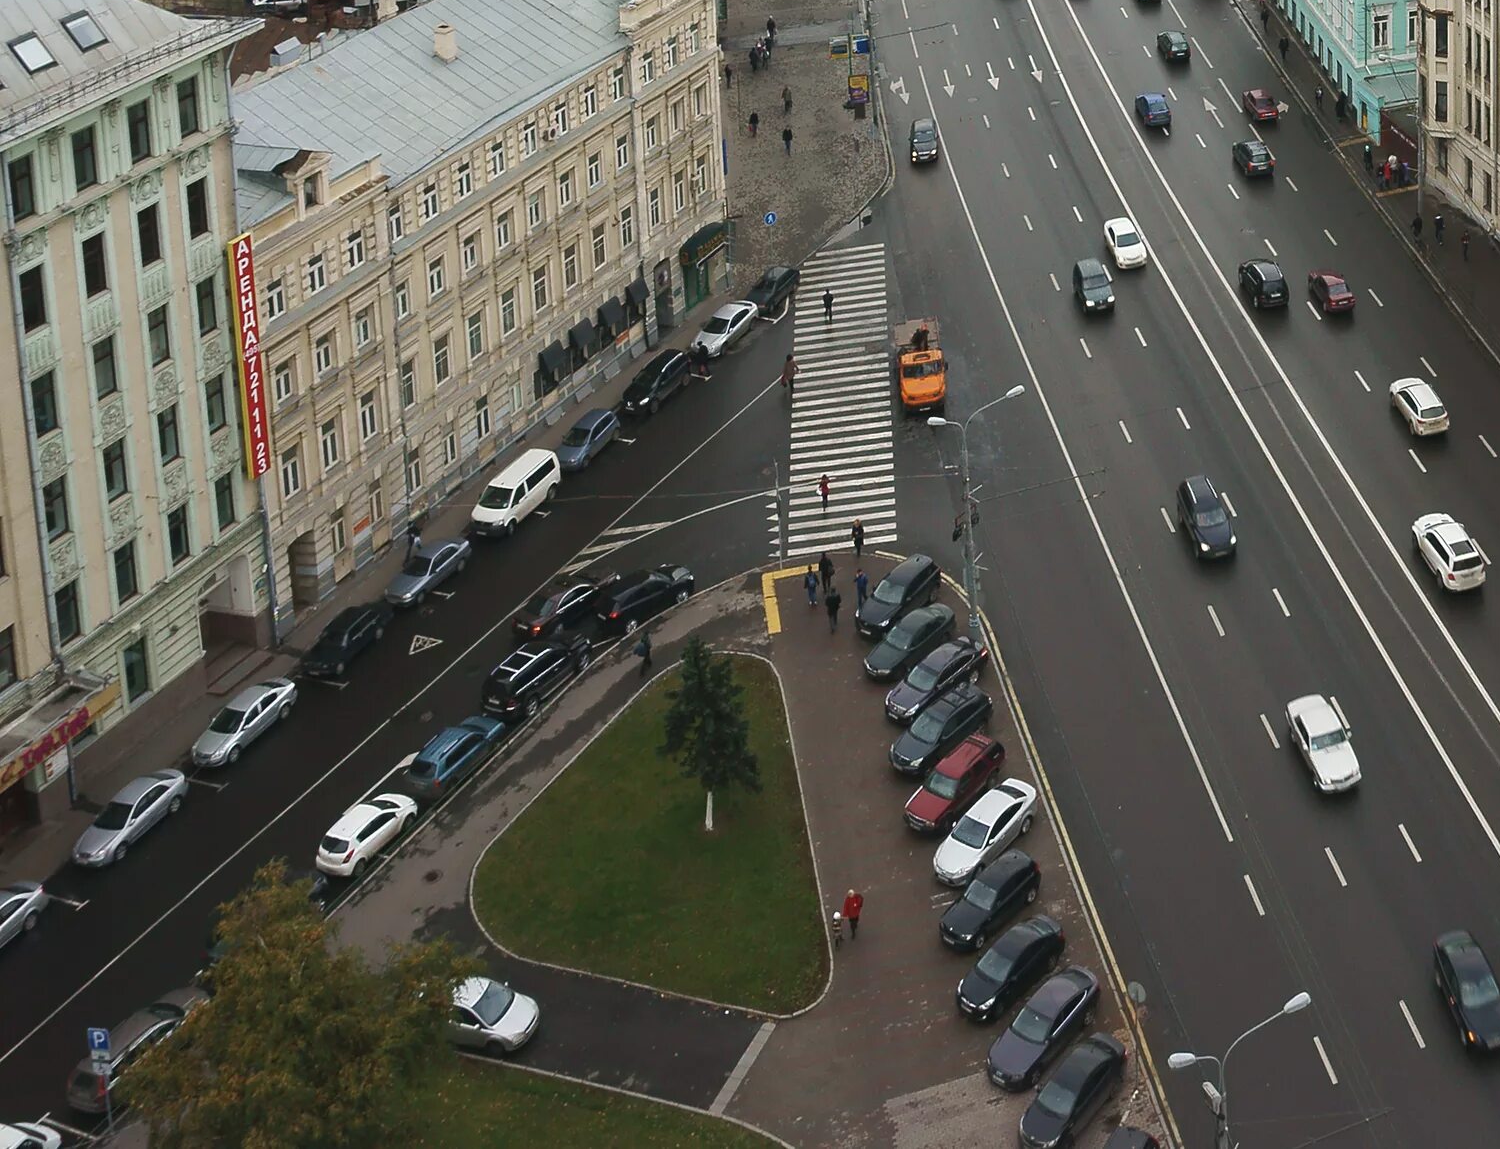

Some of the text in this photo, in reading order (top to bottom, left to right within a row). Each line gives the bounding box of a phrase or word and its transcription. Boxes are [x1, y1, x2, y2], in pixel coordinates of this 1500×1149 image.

[237, 240, 257, 349] АРЕНДА
[248, 356, 259, 403] 721
[252, 407, 261, 438] 11
[256, 442, 267, 473] 23
[93, 1031, 105, 1048] P
